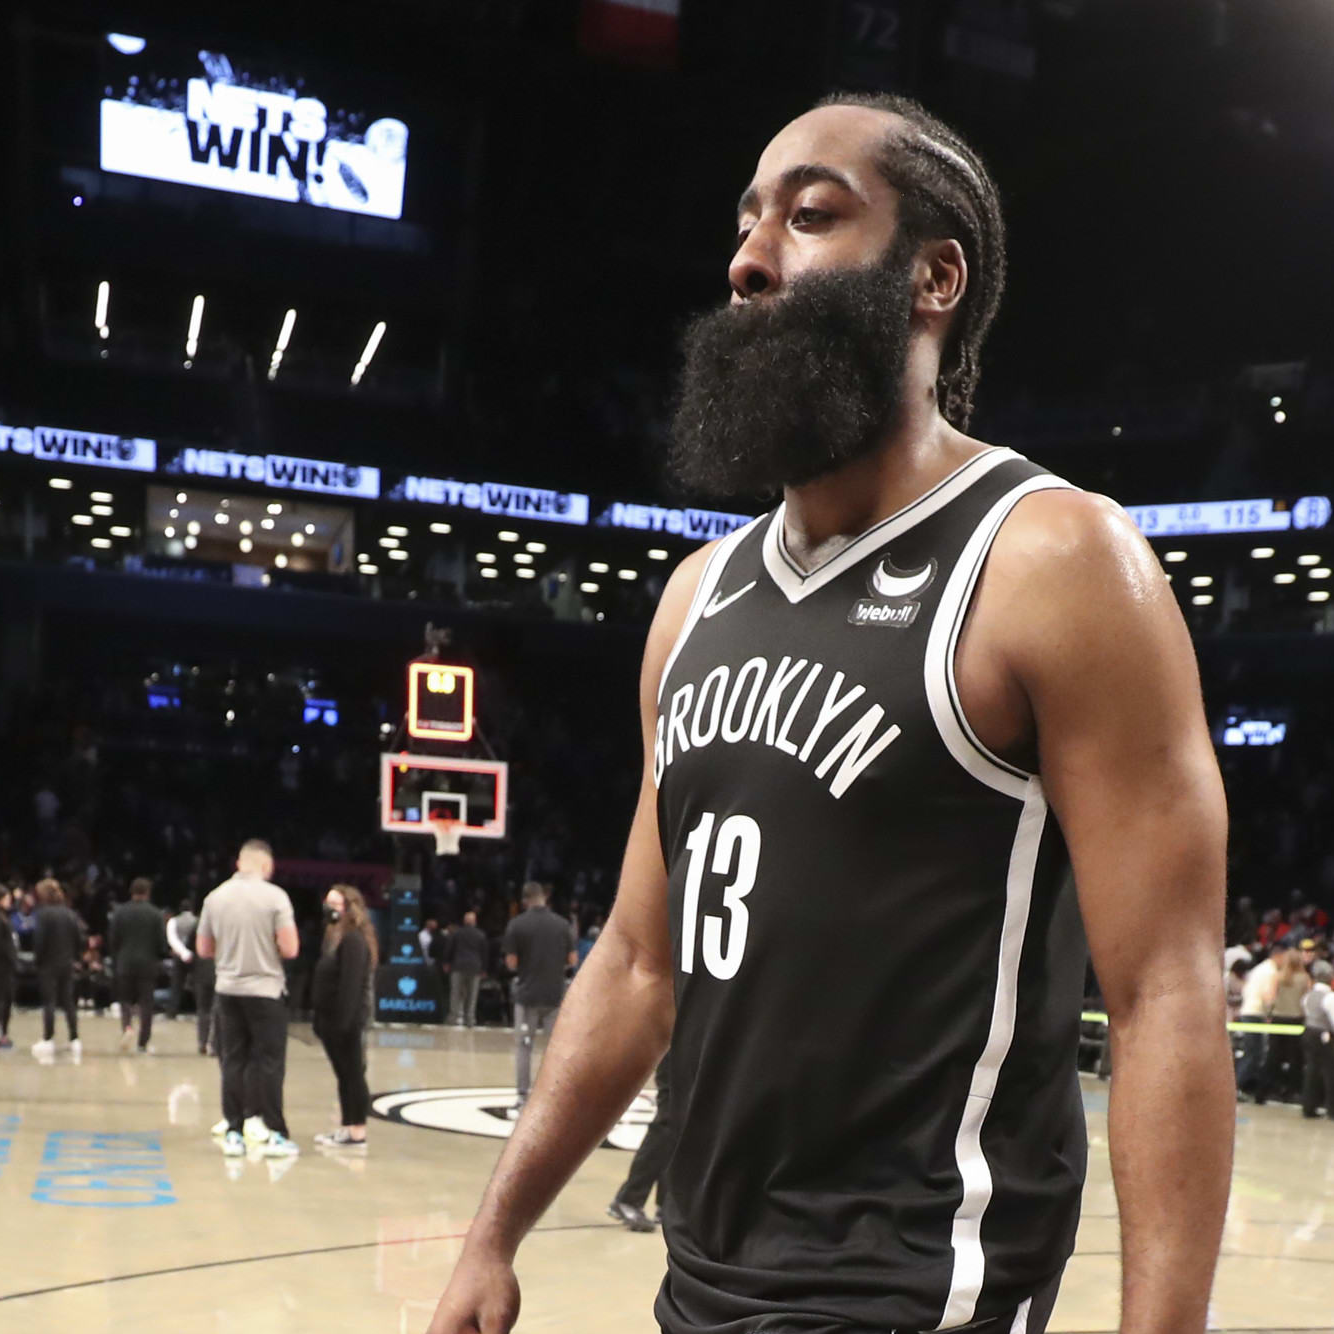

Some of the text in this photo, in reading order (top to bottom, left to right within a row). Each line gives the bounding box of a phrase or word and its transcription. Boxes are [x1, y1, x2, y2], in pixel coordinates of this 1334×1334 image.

[188, 77, 328, 143] NETS
[187, 119, 325, 185] WIN!
[183, 448, 265, 482] NETS
[405, 475, 482, 509] NETS
[611, 502, 684, 535] NETS
[1223, 505, 1261, 526] 115
[856, 604, 913, 622] Webull
[653, 655, 902, 799] BROOKLYN
[681, 811, 762, 980] 13
